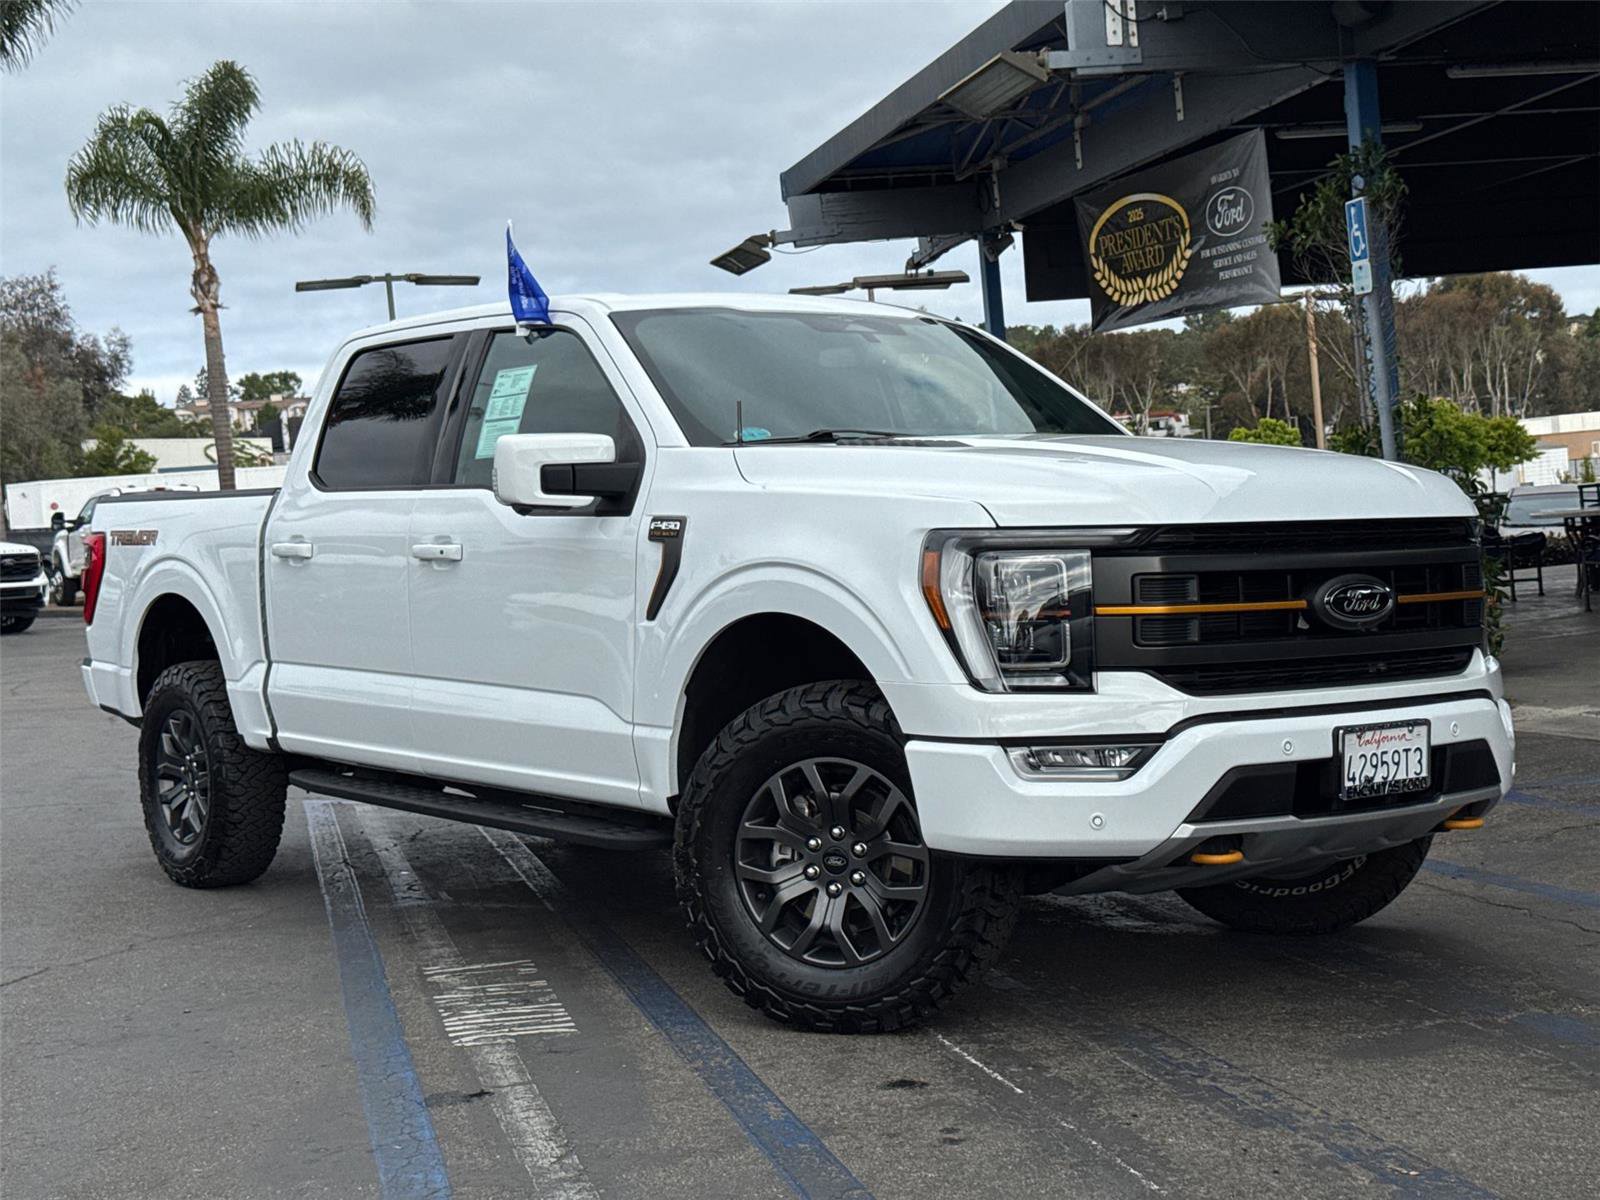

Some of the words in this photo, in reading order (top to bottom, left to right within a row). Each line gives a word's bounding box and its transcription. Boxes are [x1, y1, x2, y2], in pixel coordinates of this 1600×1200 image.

[1127, 207, 1144, 223] 2025
[1215, 194, 1245, 229] Ford
[1099, 215, 1181, 257] PRESIDENT'S
[1121, 244, 1165, 275] AWARD
[110, 530, 159, 546] TREMOR
[650, 521, 681, 530] F-150
[1344, 590, 1381, 612] Ford
[1358, 728, 1413, 750] California
[1347, 747, 1423, 786] 42959T3
[1234, 855, 1367, 897] BFGoodric
